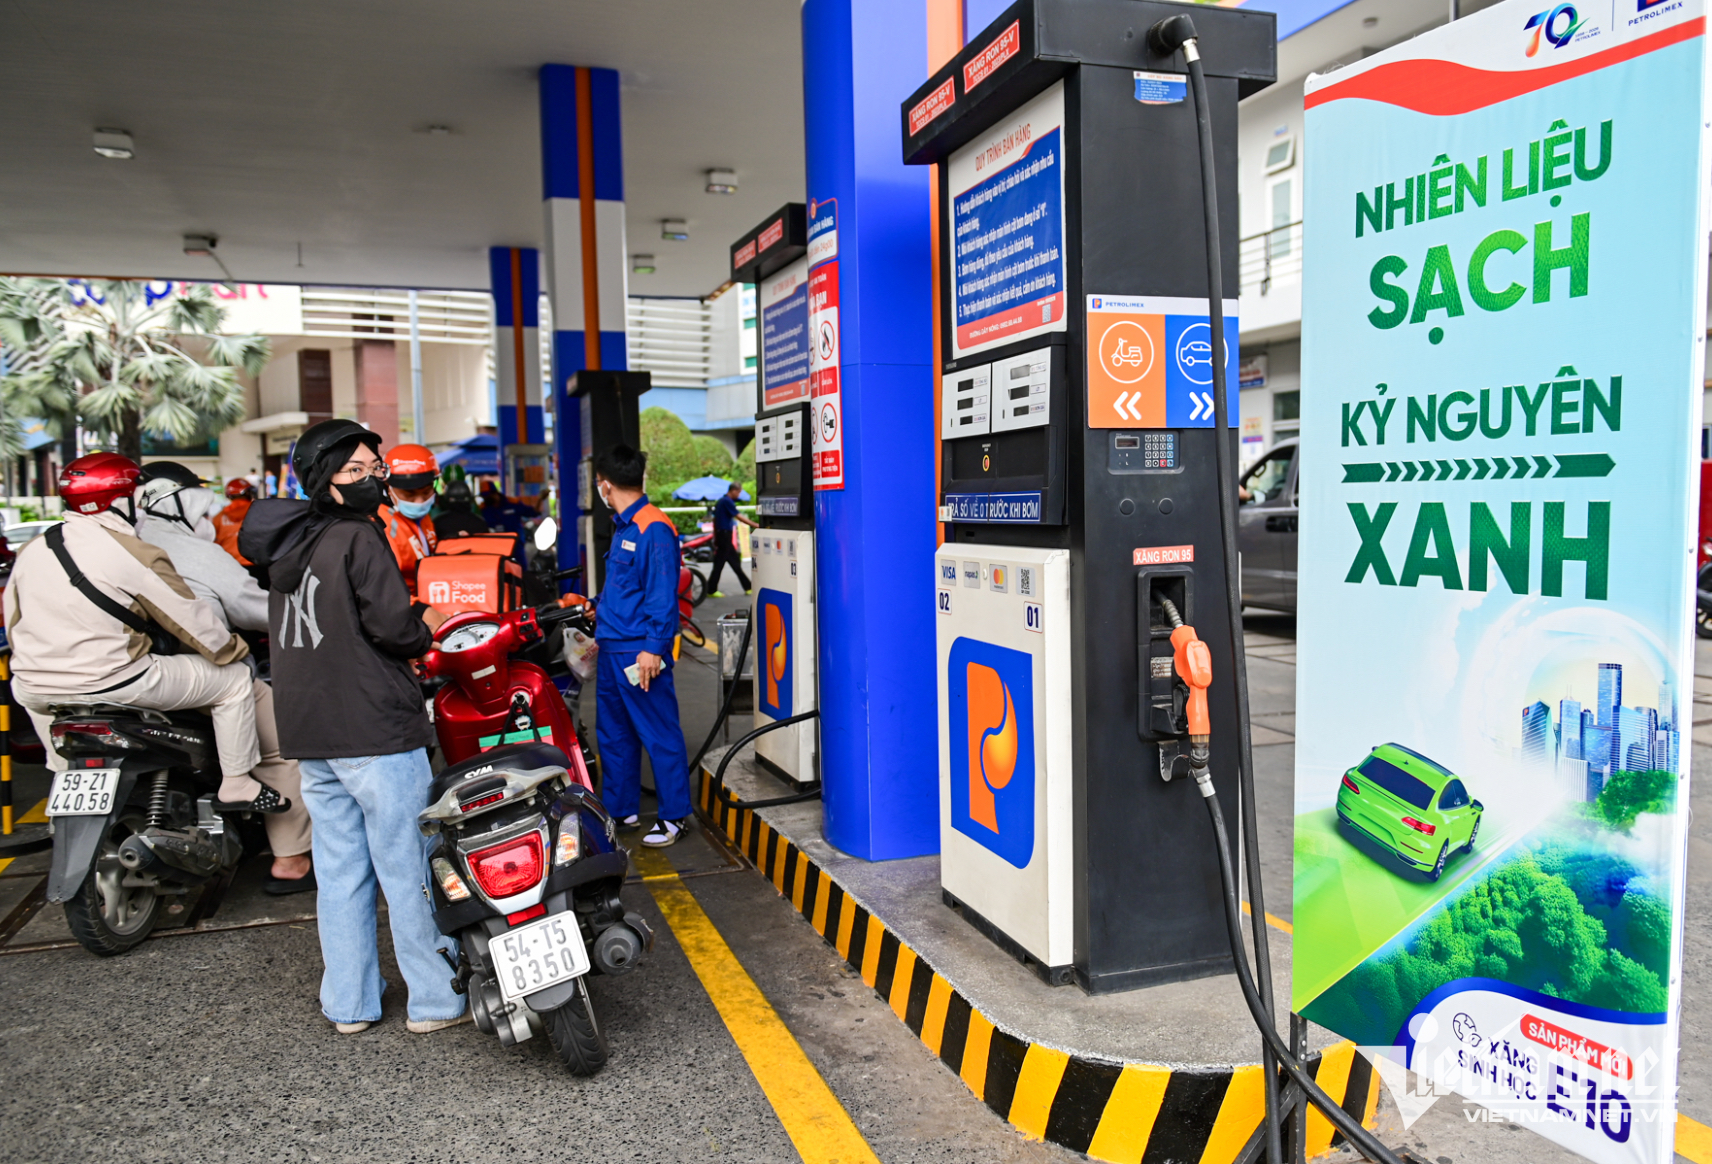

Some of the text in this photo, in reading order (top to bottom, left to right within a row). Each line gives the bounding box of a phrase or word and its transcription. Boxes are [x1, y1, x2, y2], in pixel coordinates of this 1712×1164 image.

[1628, 1, 1683, 26] PETROLIMEX
[968, 57, 985, 78] XĂNG
[985, 44, 1000, 64] RON
[1003, 132, 1015, 155] BÁN
[1015, 123, 1031, 146] HÀNG
[1356, 118, 1613, 238] NHIÊN LIỆU
[1367, 211, 1590, 344] SẠCH
[1341, 382, 1397, 447] KỶ
[1406, 364, 1622, 443] NGUYÊN
[960, 498, 969, 517] SỐ
[1009, 502, 1021, 518] KHI
[1022, 500, 1038, 518] BƠM
[1135, 549, 1191, 564] XĂNG RON 95
[1344, 500, 1611, 601] XANH
[791, 562, 797, 576] 03
[941, 565, 956, 580] VISA
[452, 580, 486, 592] Shopee
[452, 591, 486, 603] Food
[939, 592, 950, 611] 02
[1027, 605, 1039, 628] 01
[51, 792, 110, 811] 440.58
[511, 948, 575, 990] 8350
[1488, 1036, 1537, 1075] XĂNG
[1529, 1022, 1626, 1076] SẢN PHẨM MỚI
[1458, 1049, 1536, 1100] SINH HỌC
[1547, 1062, 1632, 1143] E10
